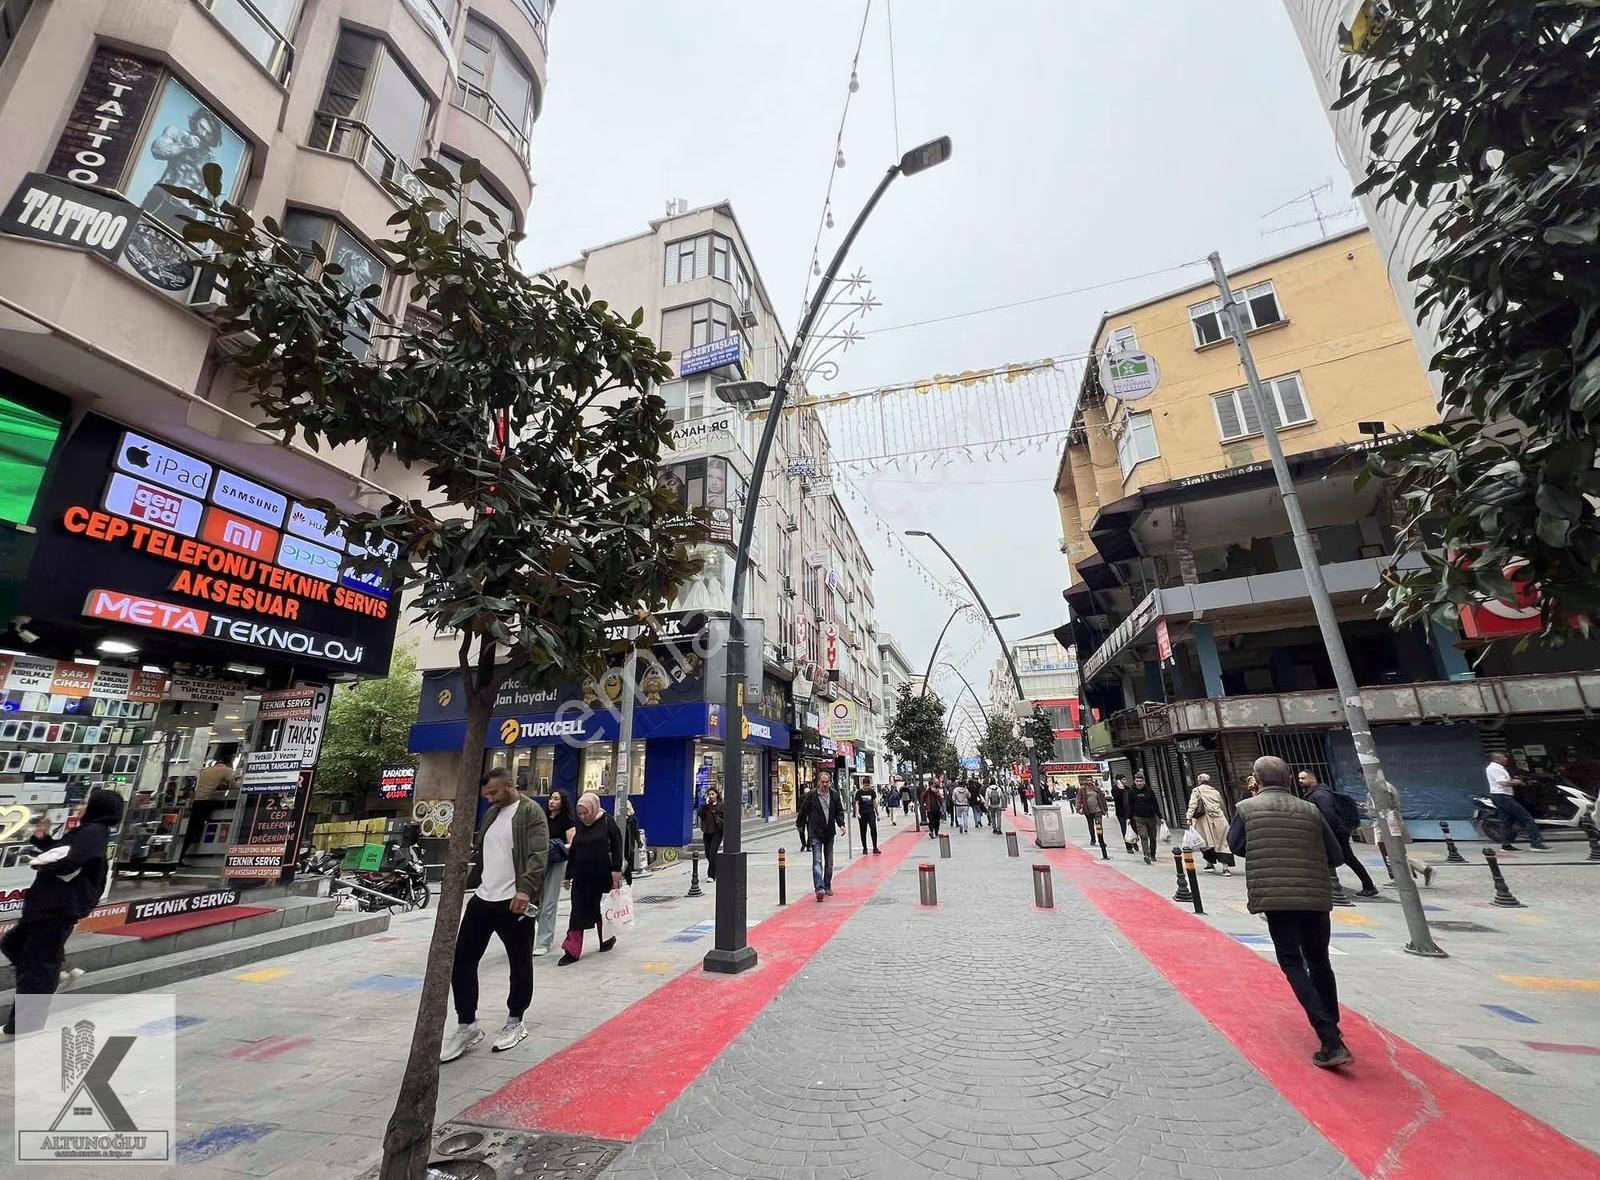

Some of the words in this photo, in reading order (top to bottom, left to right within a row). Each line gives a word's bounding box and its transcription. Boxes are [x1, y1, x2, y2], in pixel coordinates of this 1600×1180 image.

[67, 82, 132, 184] TATTOO
[17, 187, 128, 250] TATTOO
[138, 224, 189, 262] TATTOO
[155, 454, 208, 490] iPad
[1181, 474, 1210, 487] simit
[221, 483, 280, 514] SAMSUNG
[63, 506, 127, 543] CEP
[131, 526, 257, 586] TELEFONU
[282, 544, 339, 569] oppo
[172, 571, 300, 620] AKSESUAR
[94, 594, 201, 634] META
[826, 637, 837, 669] THY
[19, 678, 39, 686] CAM
[191, 693, 225, 702] BURADA
[288, 724, 319, 745] TAKAS
[519, 720, 586, 738] TURKCELL
[257, 821, 296, 830] TELEFONU
[270, 811, 288, 820] CEP
